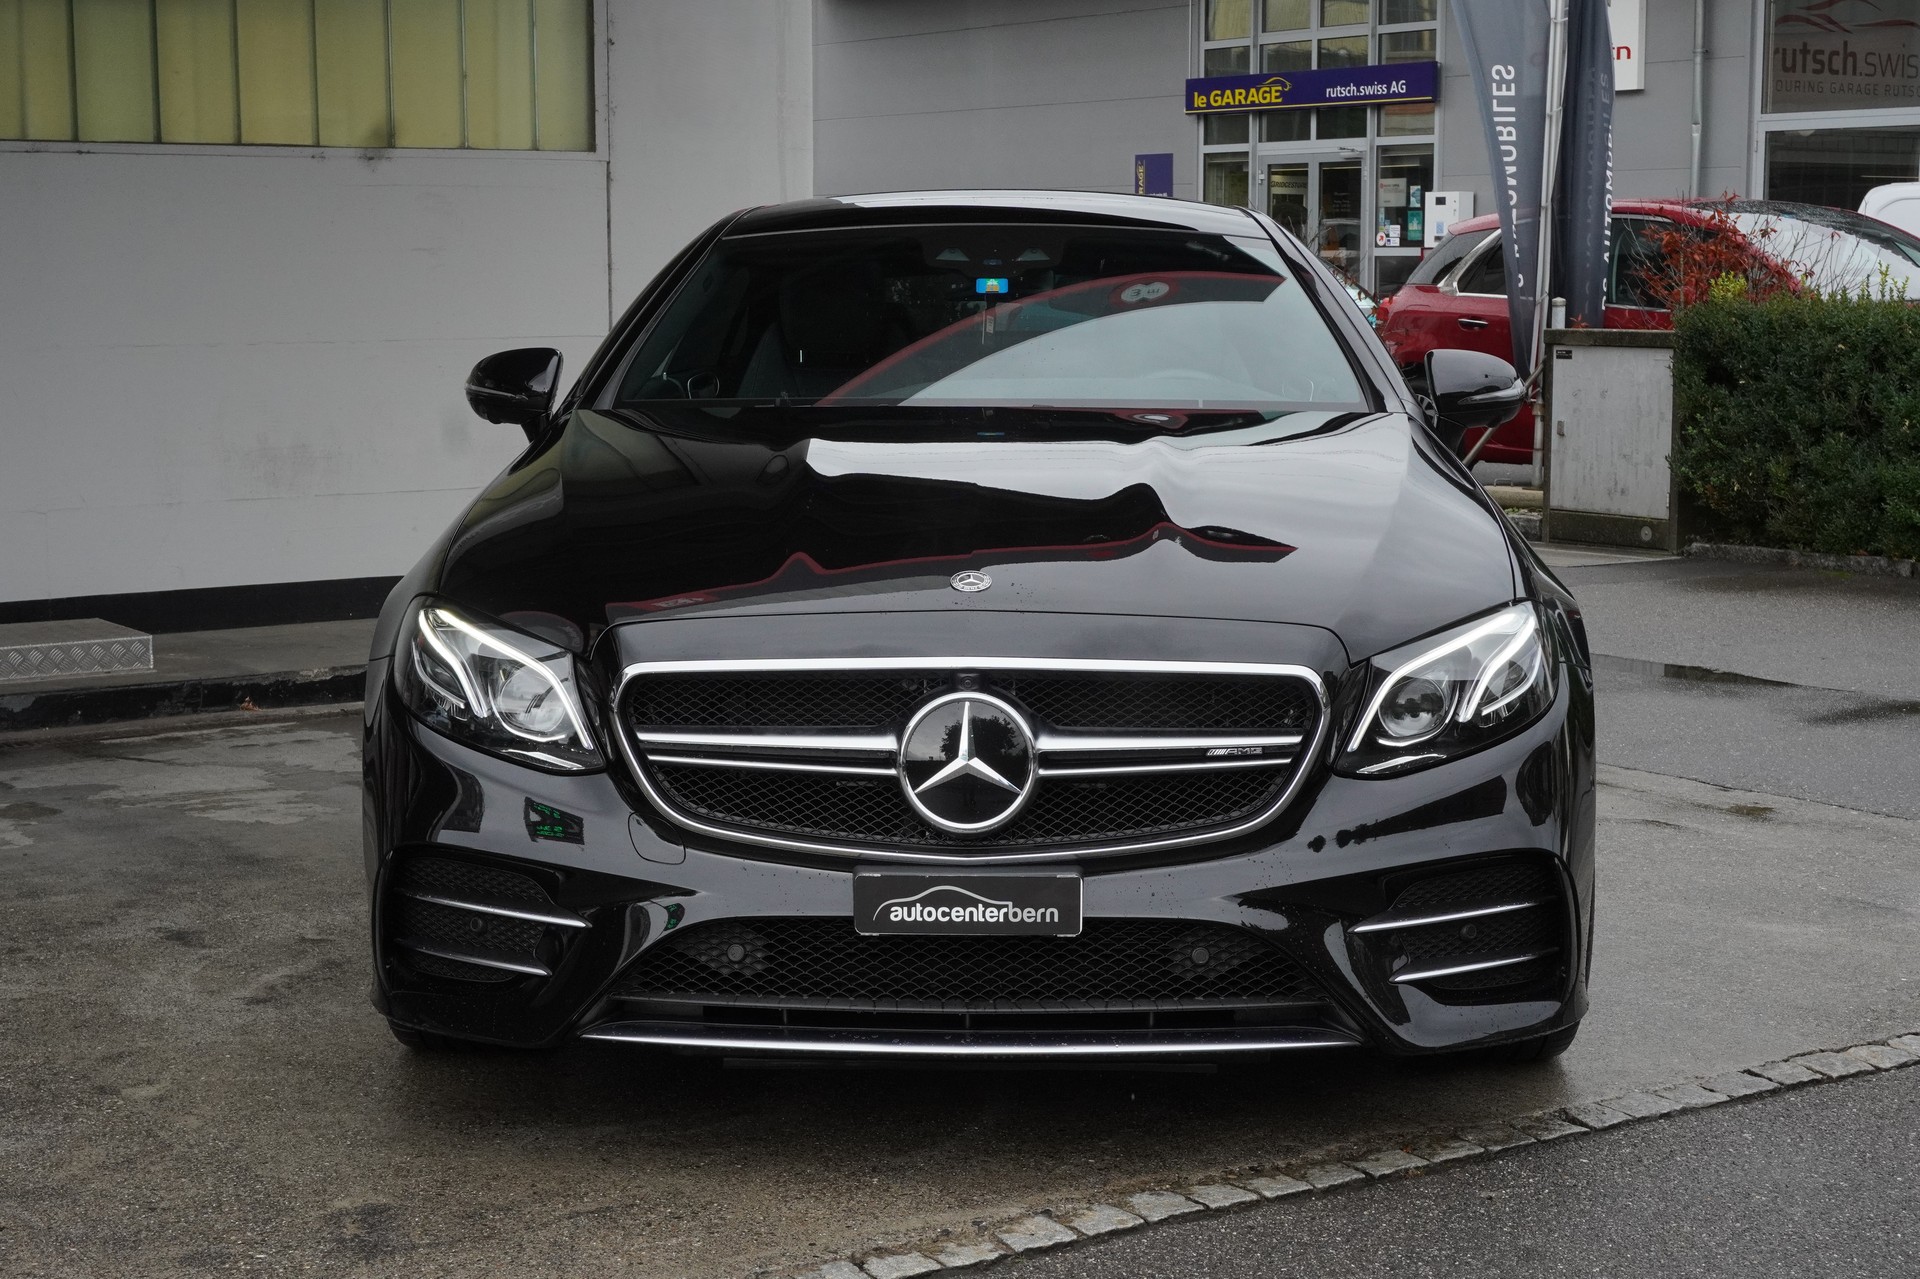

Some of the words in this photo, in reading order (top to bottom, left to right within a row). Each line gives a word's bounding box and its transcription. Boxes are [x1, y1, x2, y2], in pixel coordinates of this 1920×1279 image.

[1194, 92, 1207, 107] le
[1209, 86, 1283, 107] GARAGE
[1326, 81, 1388, 98] rutsch.swiss
[1390, 80, 1407, 94] AG
[1775, 80, 1824, 94] OURING
[1830, 82, 1879, 96] GARAGE
[1217, 746, 1263, 757] AMG
[889, 902, 1059, 923] autocenterbern
